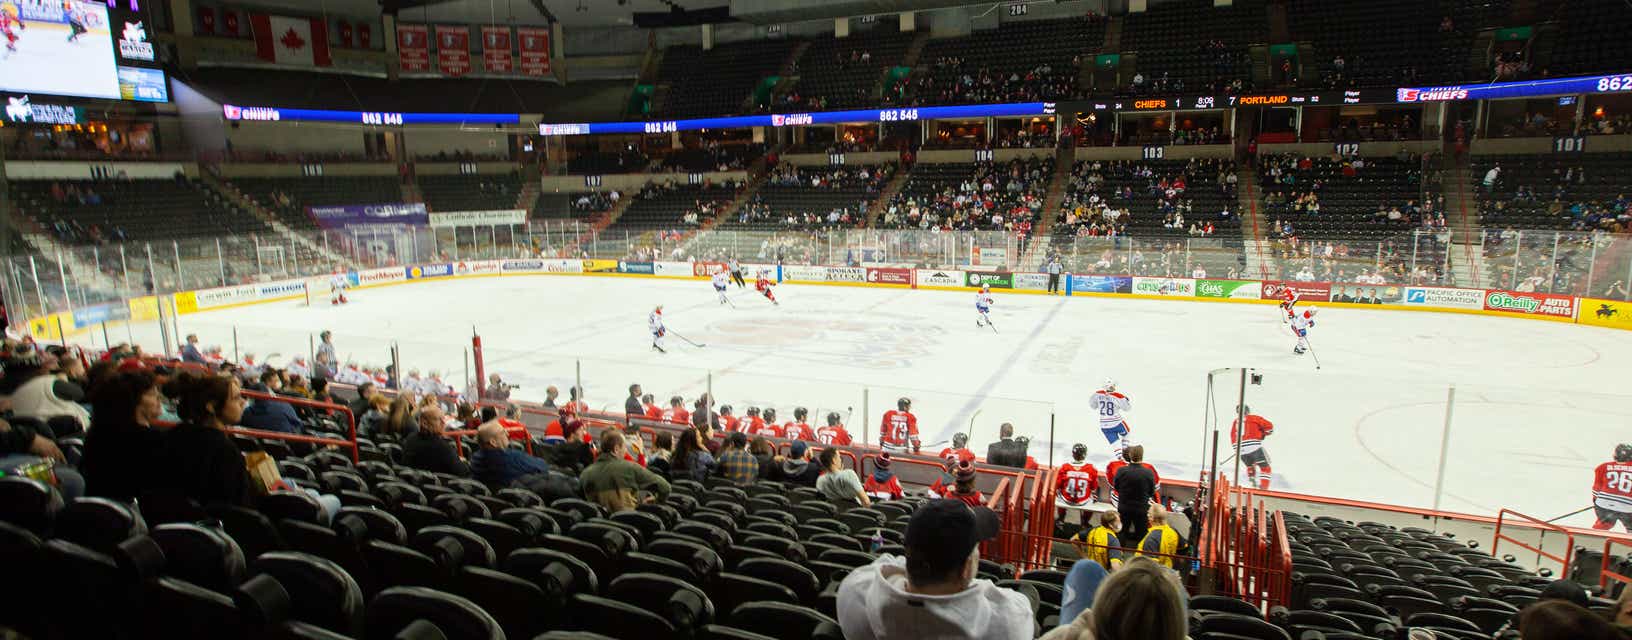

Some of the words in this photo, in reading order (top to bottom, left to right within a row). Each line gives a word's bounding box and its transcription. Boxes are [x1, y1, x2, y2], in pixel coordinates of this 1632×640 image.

[1597, 76, 1632, 92] 862
[1420, 89, 1468, 101] CHIEFS
[1134, 99, 1166, 109] CHIEFS
[1229, 96, 1236, 106] 7
[1240, 96, 1287, 105] PORTLAND
[880, 110, 898, 121] 862
[1336, 143, 1359, 156] 102
[1556, 138, 1584, 152] 101
[976, 150, 993, 161] 104
[1144, 147, 1163, 158] 103
[1427, 296, 1477, 304] AUTOMATION
[1545, 298, 1570, 307] AUTO
[1541, 306, 1571, 316] PARTS
[1099, 400, 1115, 416] 28
[1605, 470, 1632, 493] 26
[1066, 478, 1089, 498] 43
